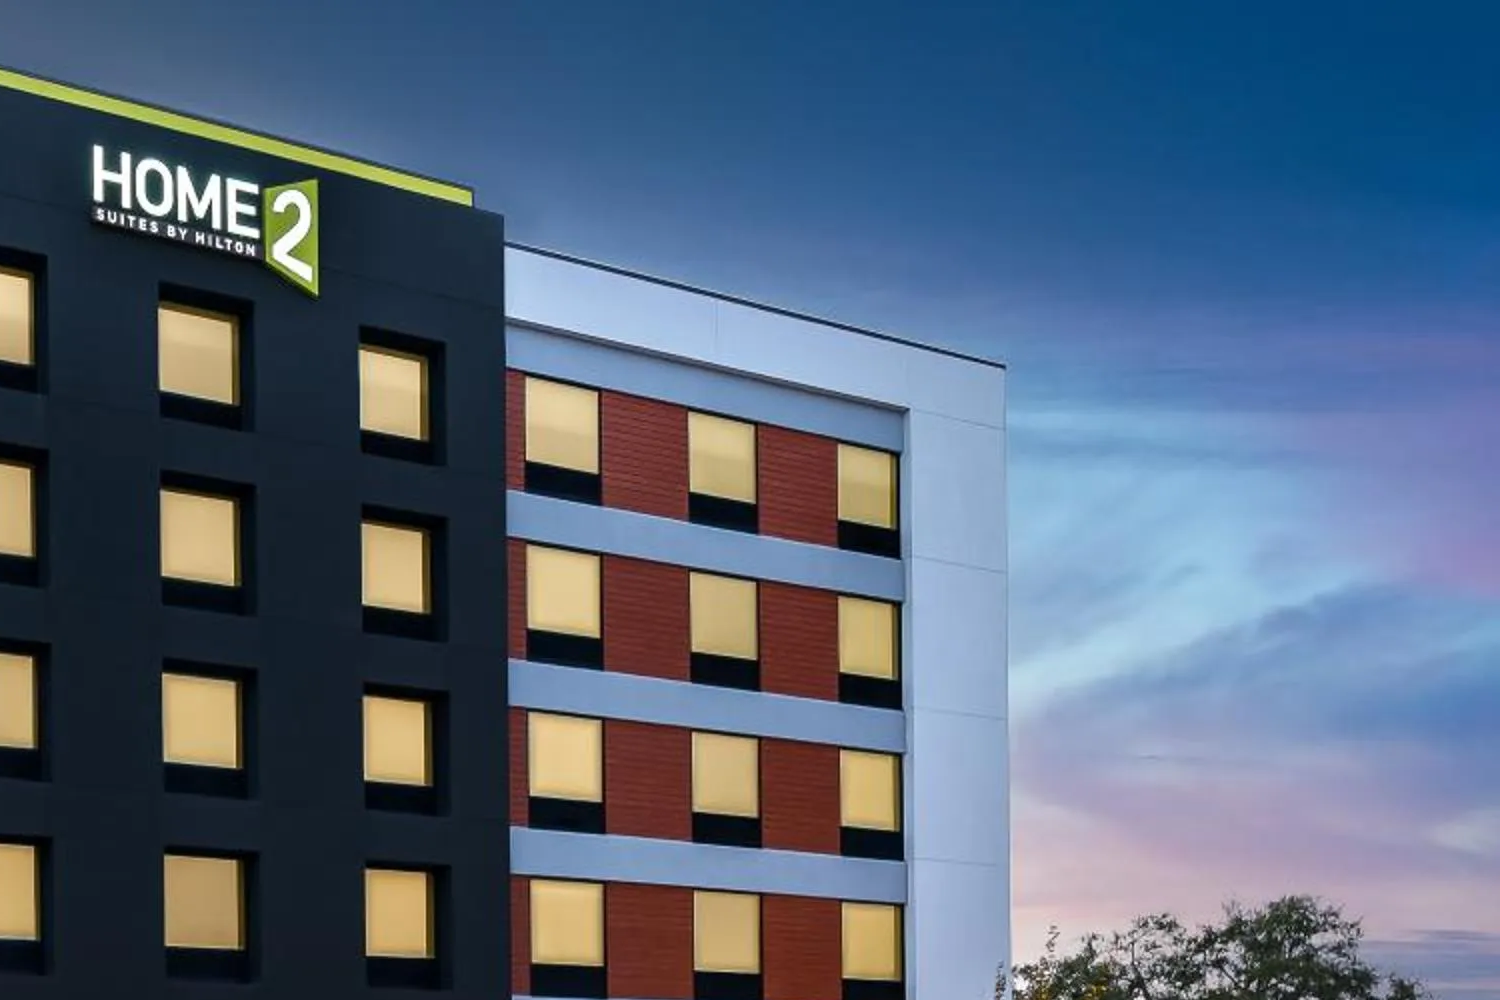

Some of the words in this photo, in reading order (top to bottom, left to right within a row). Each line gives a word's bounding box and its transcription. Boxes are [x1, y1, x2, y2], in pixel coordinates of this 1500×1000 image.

[92, 144, 260, 239] HOME
[272, 189, 313, 282] 2
[96, 207, 159, 233] SUITES
[166, 225, 187, 240] BY
[195, 231, 256, 257] HILTON
